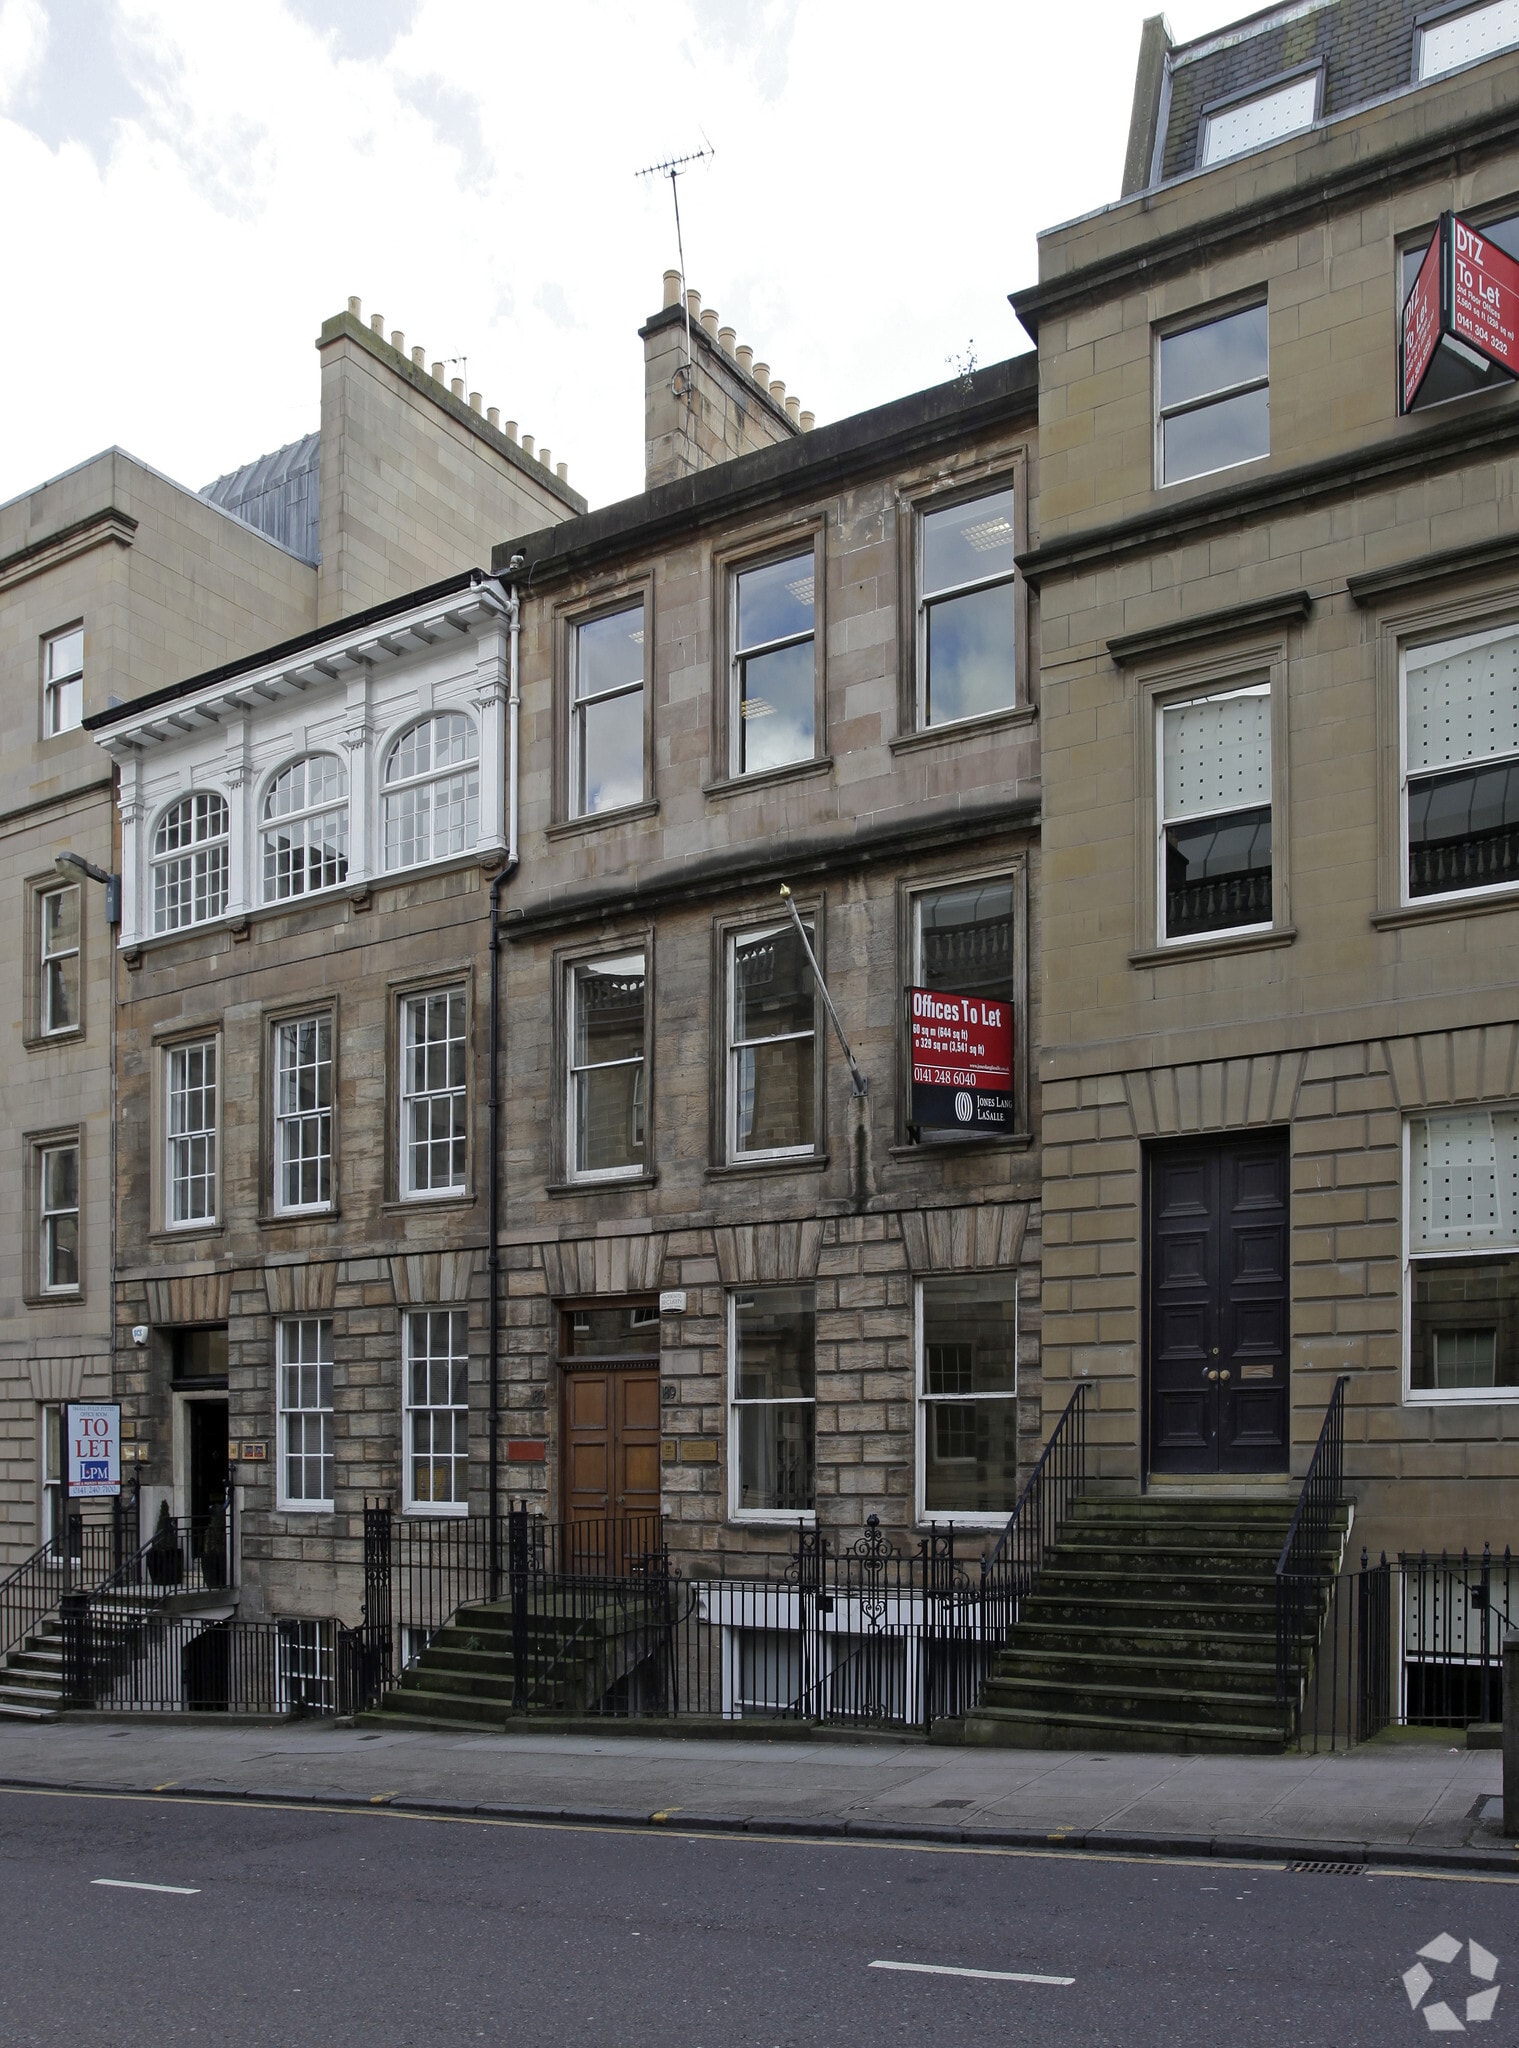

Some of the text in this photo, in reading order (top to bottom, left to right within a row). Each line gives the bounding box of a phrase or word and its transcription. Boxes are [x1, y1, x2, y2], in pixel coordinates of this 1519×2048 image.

[1457, 224, 1484, 267] DTZ
[1457, 259, 1500, 309] To Let
[1457, 283, 1500, 319] 2nd Floor Offices
[1406, 278, 1420, 328] DTZ
[1416, 294, 1428, 334] Let
[1457, 312, 1508, 356] 0141 304 3232
[913, 993, 1002, 1028] Offices To Let
[920, 1037, 932, 1049] 329
[933, 1041, 941, 1052] sq
[941, 1042, 948, 1051] m
[969, 1045, 977, 1056] sq
[977, 1043, 985, 1056] ft)
[921, 1027, 929, 1037] sq
[930, 1028, 937, 1036] m
[937, 1026, 952, 1038] (644
[952, 1030, 960, 1041] sq
[914, 1067, 977, 1086] 0141 248 6040
[80, 1418, 109, 1436] TO
[75, 1440, 113, 1457] LET
[73, 1486, 87, 1494] 0141
